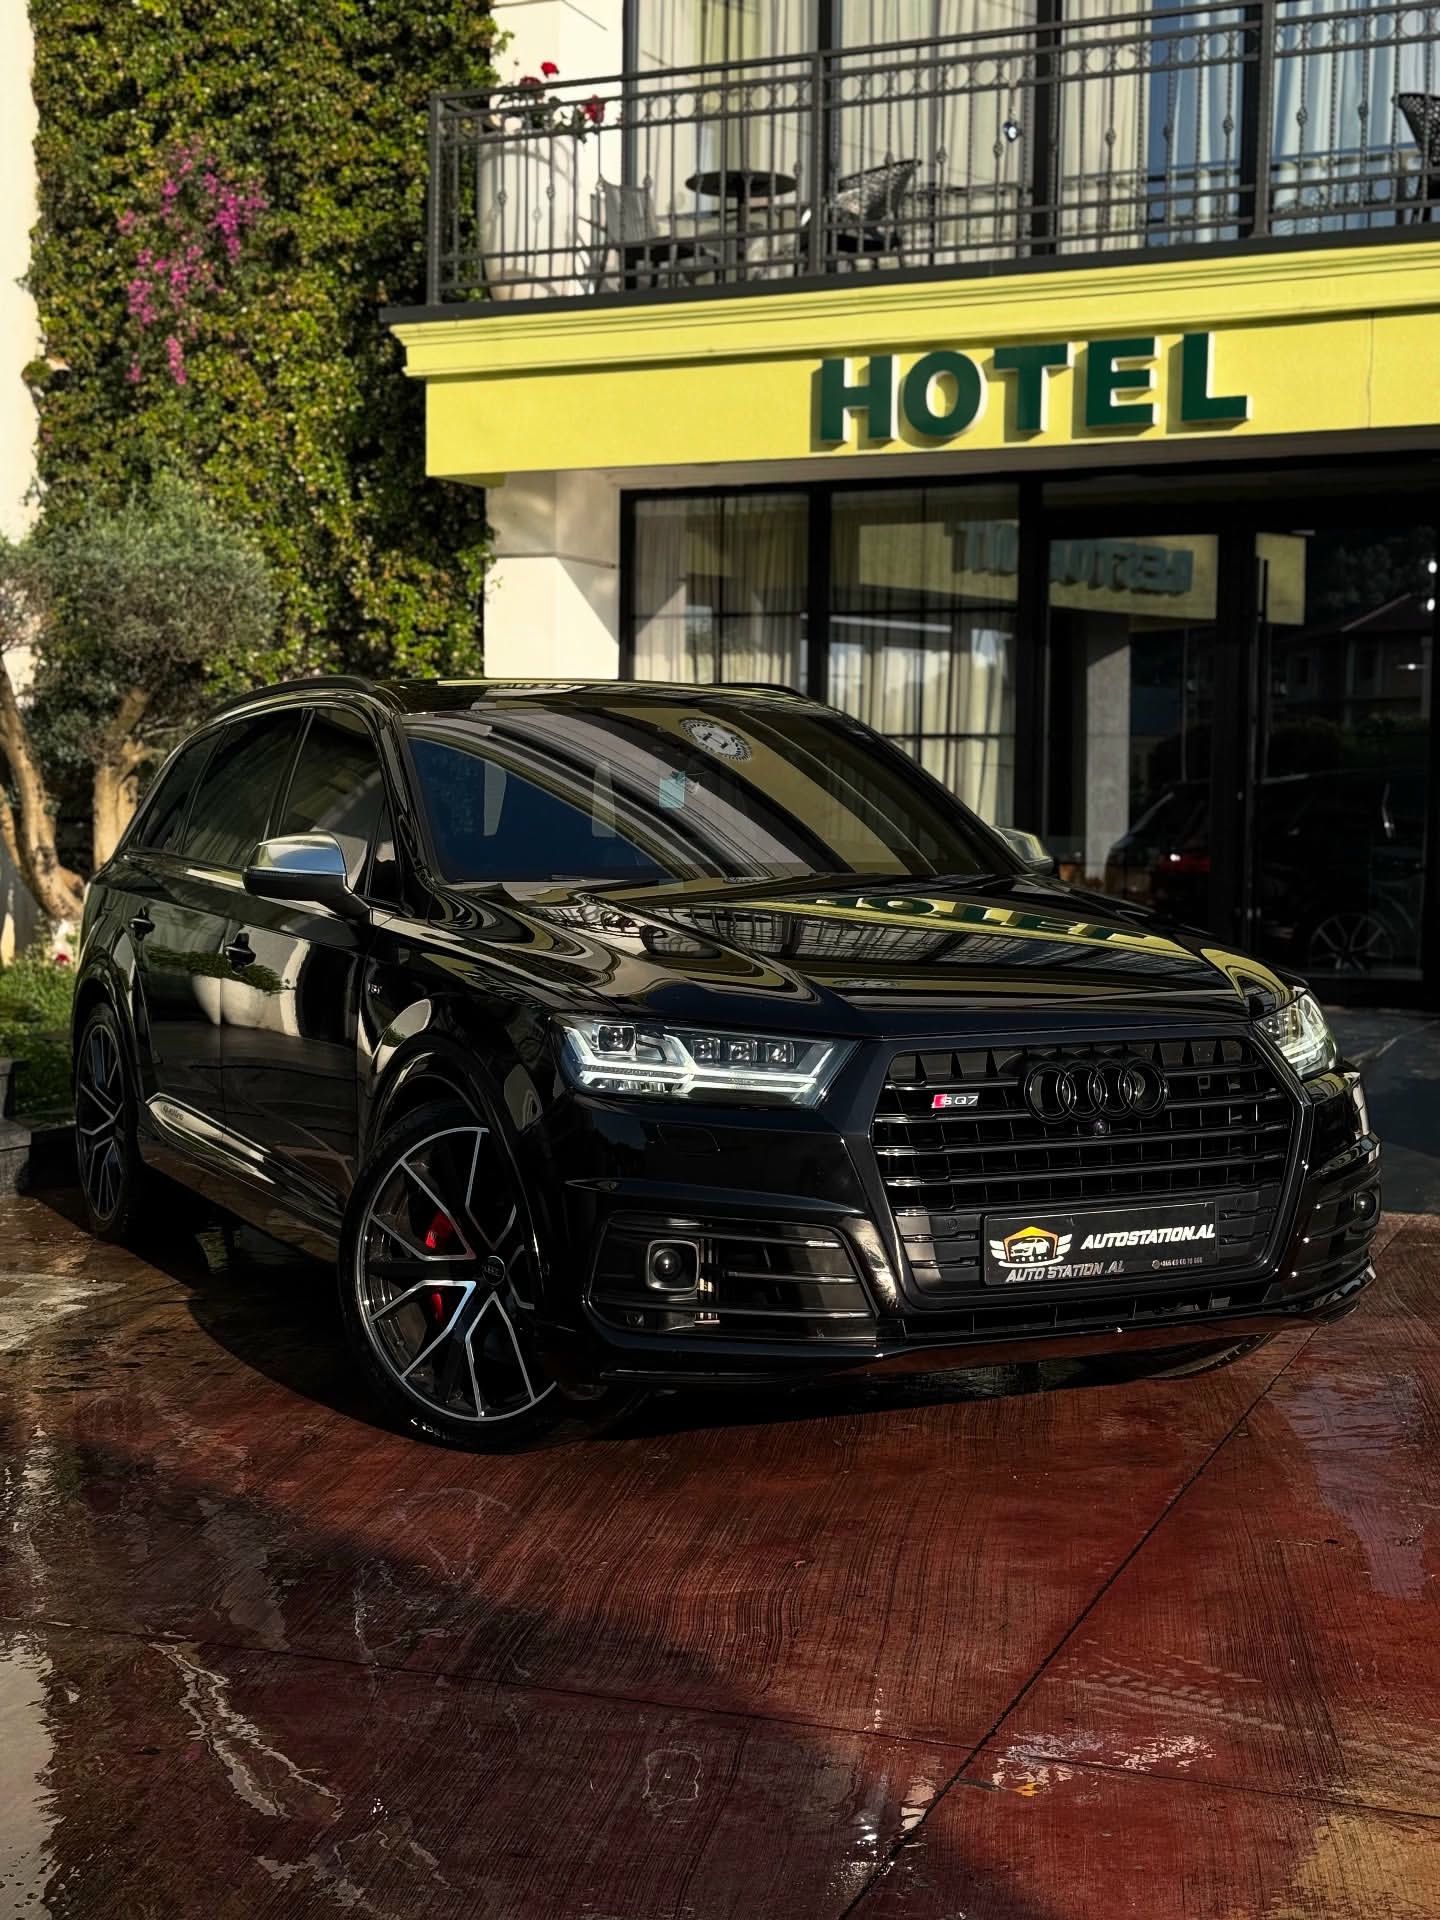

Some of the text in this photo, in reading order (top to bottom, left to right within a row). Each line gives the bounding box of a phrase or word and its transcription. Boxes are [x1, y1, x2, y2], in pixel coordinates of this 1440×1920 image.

[819, 331, 1249, 442] HOTEL
[1080, 1223, 1216, 1250] AUTOSTATION.AL
[1005, 1267, 1046, 1283] AUTO
[1047, 1261, 1105, 1279] STATION
